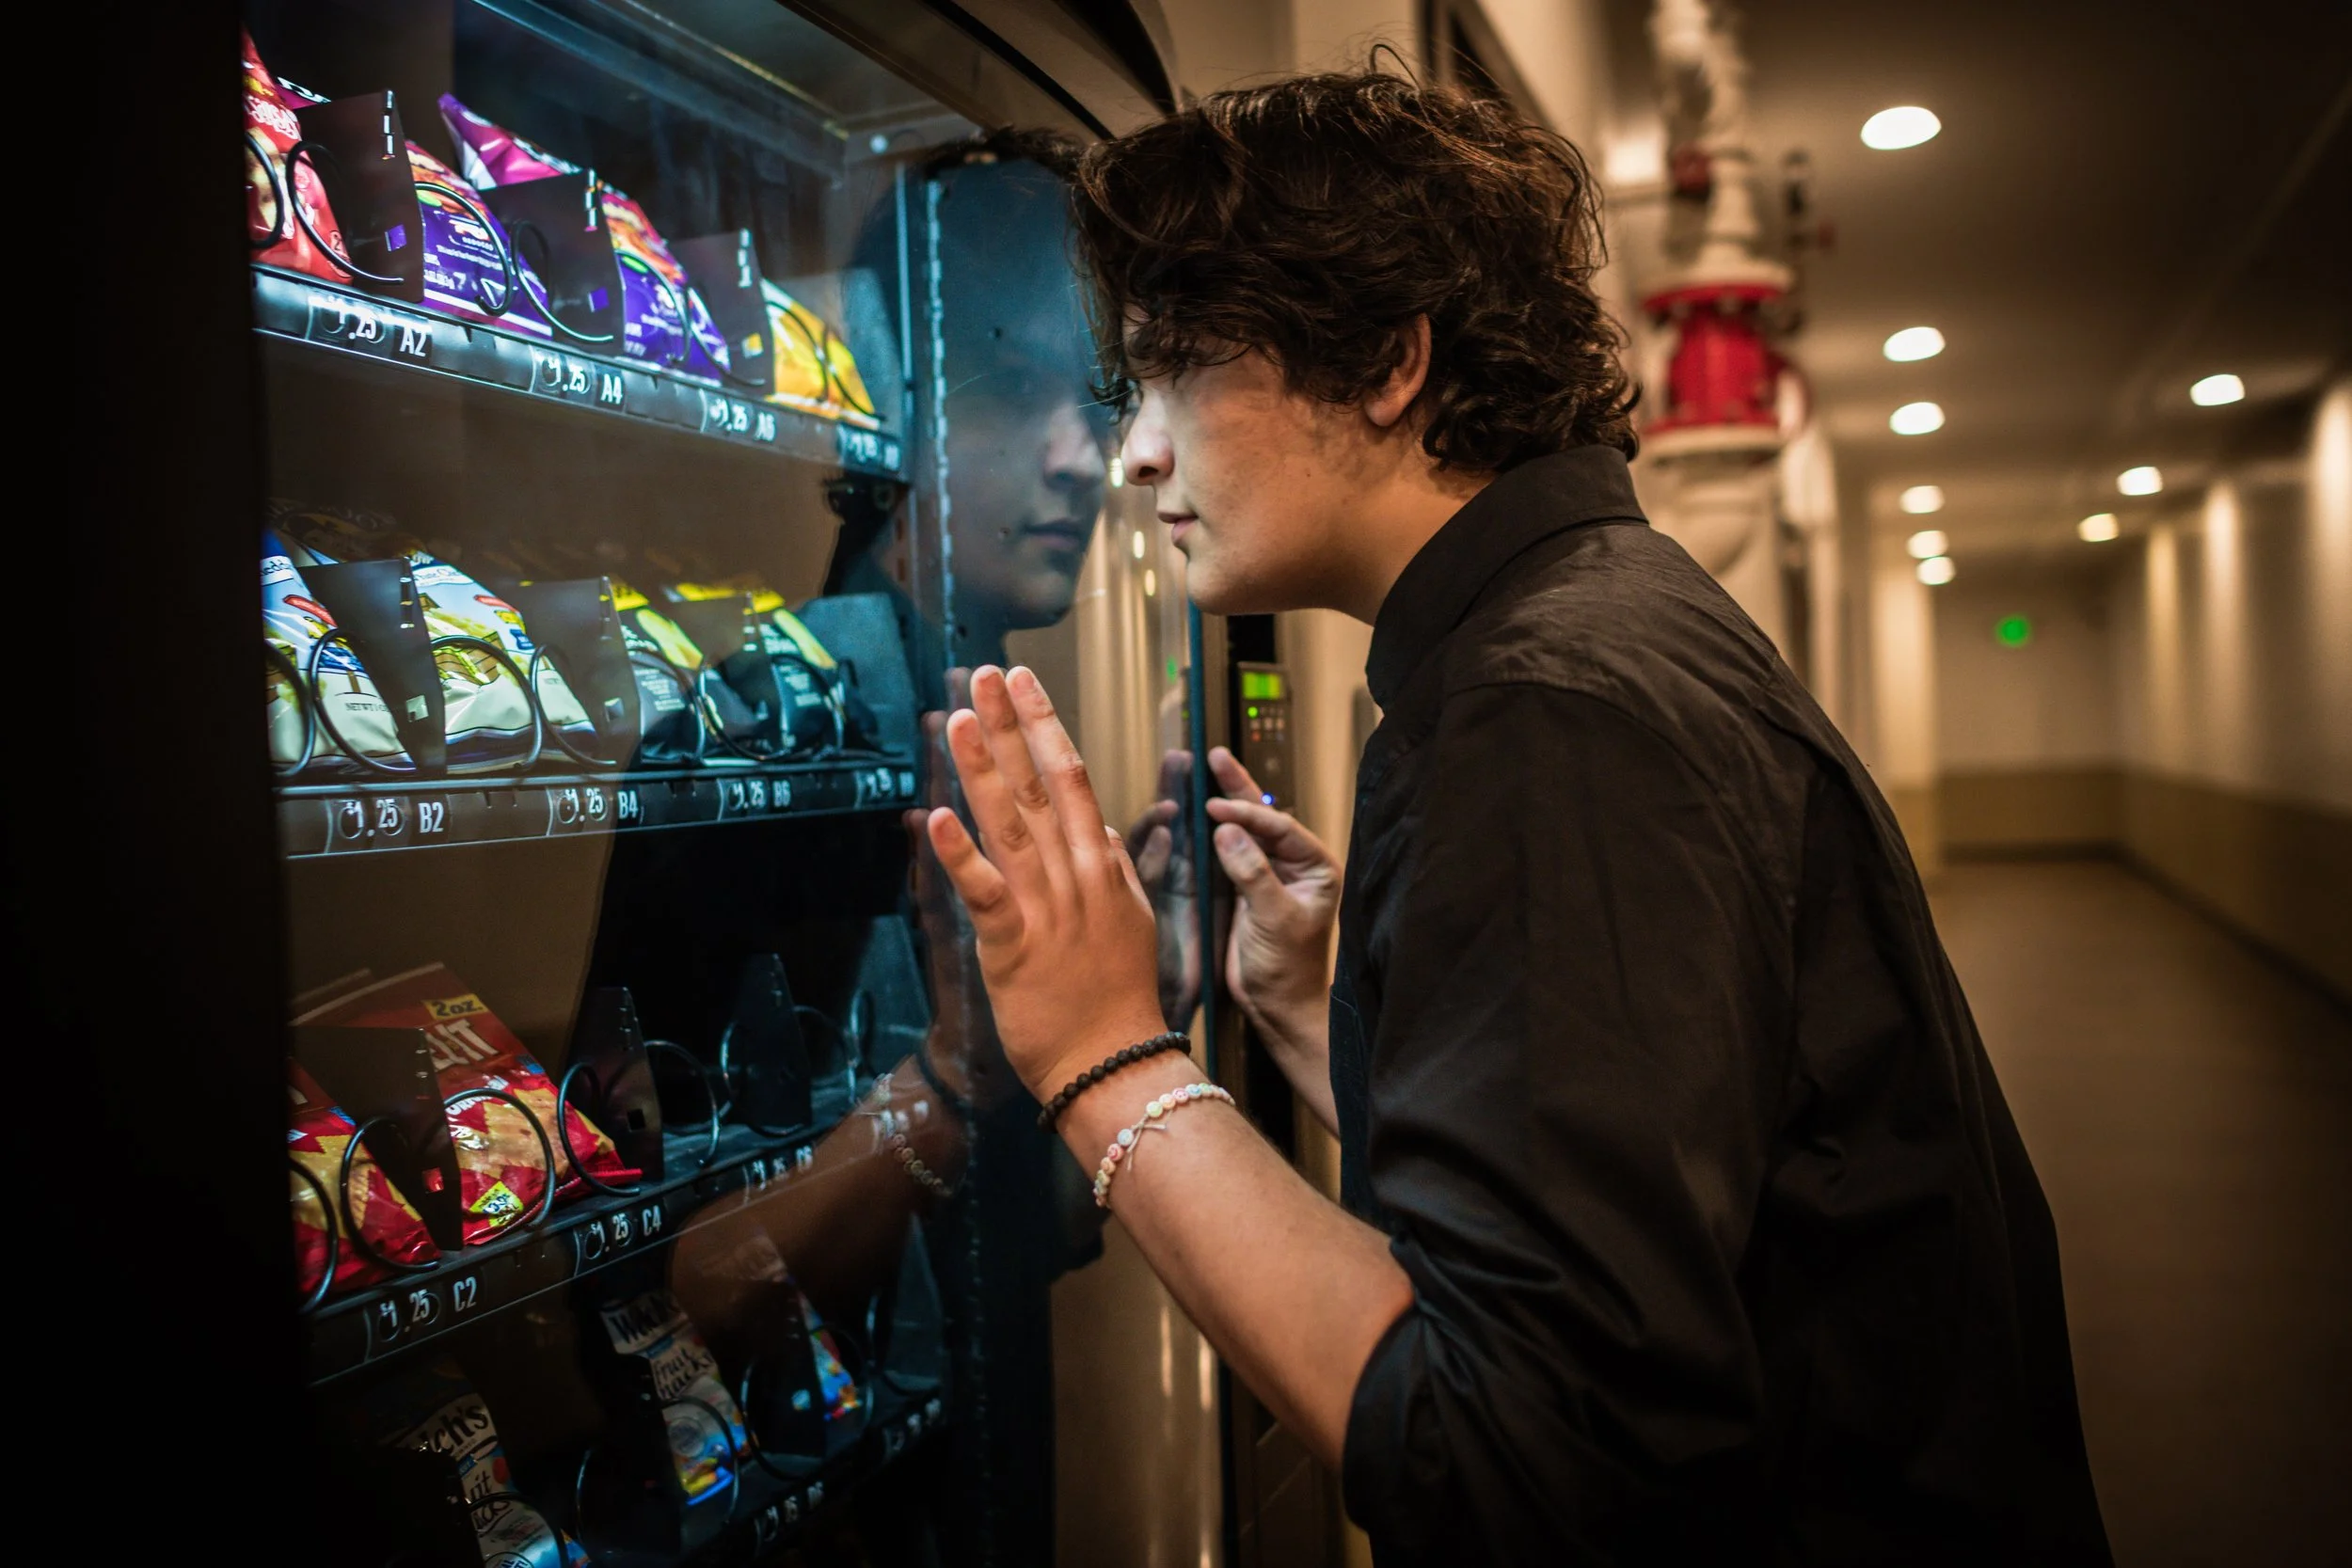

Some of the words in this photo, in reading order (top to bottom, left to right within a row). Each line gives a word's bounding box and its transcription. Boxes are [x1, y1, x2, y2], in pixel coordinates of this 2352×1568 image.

[399, 324, 428, 357] A2
[600, 372, 625, 404] A4
[418, 801, 445, 833] B2
[617, 790, 639, 819] B4
[643, 1205, 661, 1237] C4
[453, 1276, 478, 1313] C2
